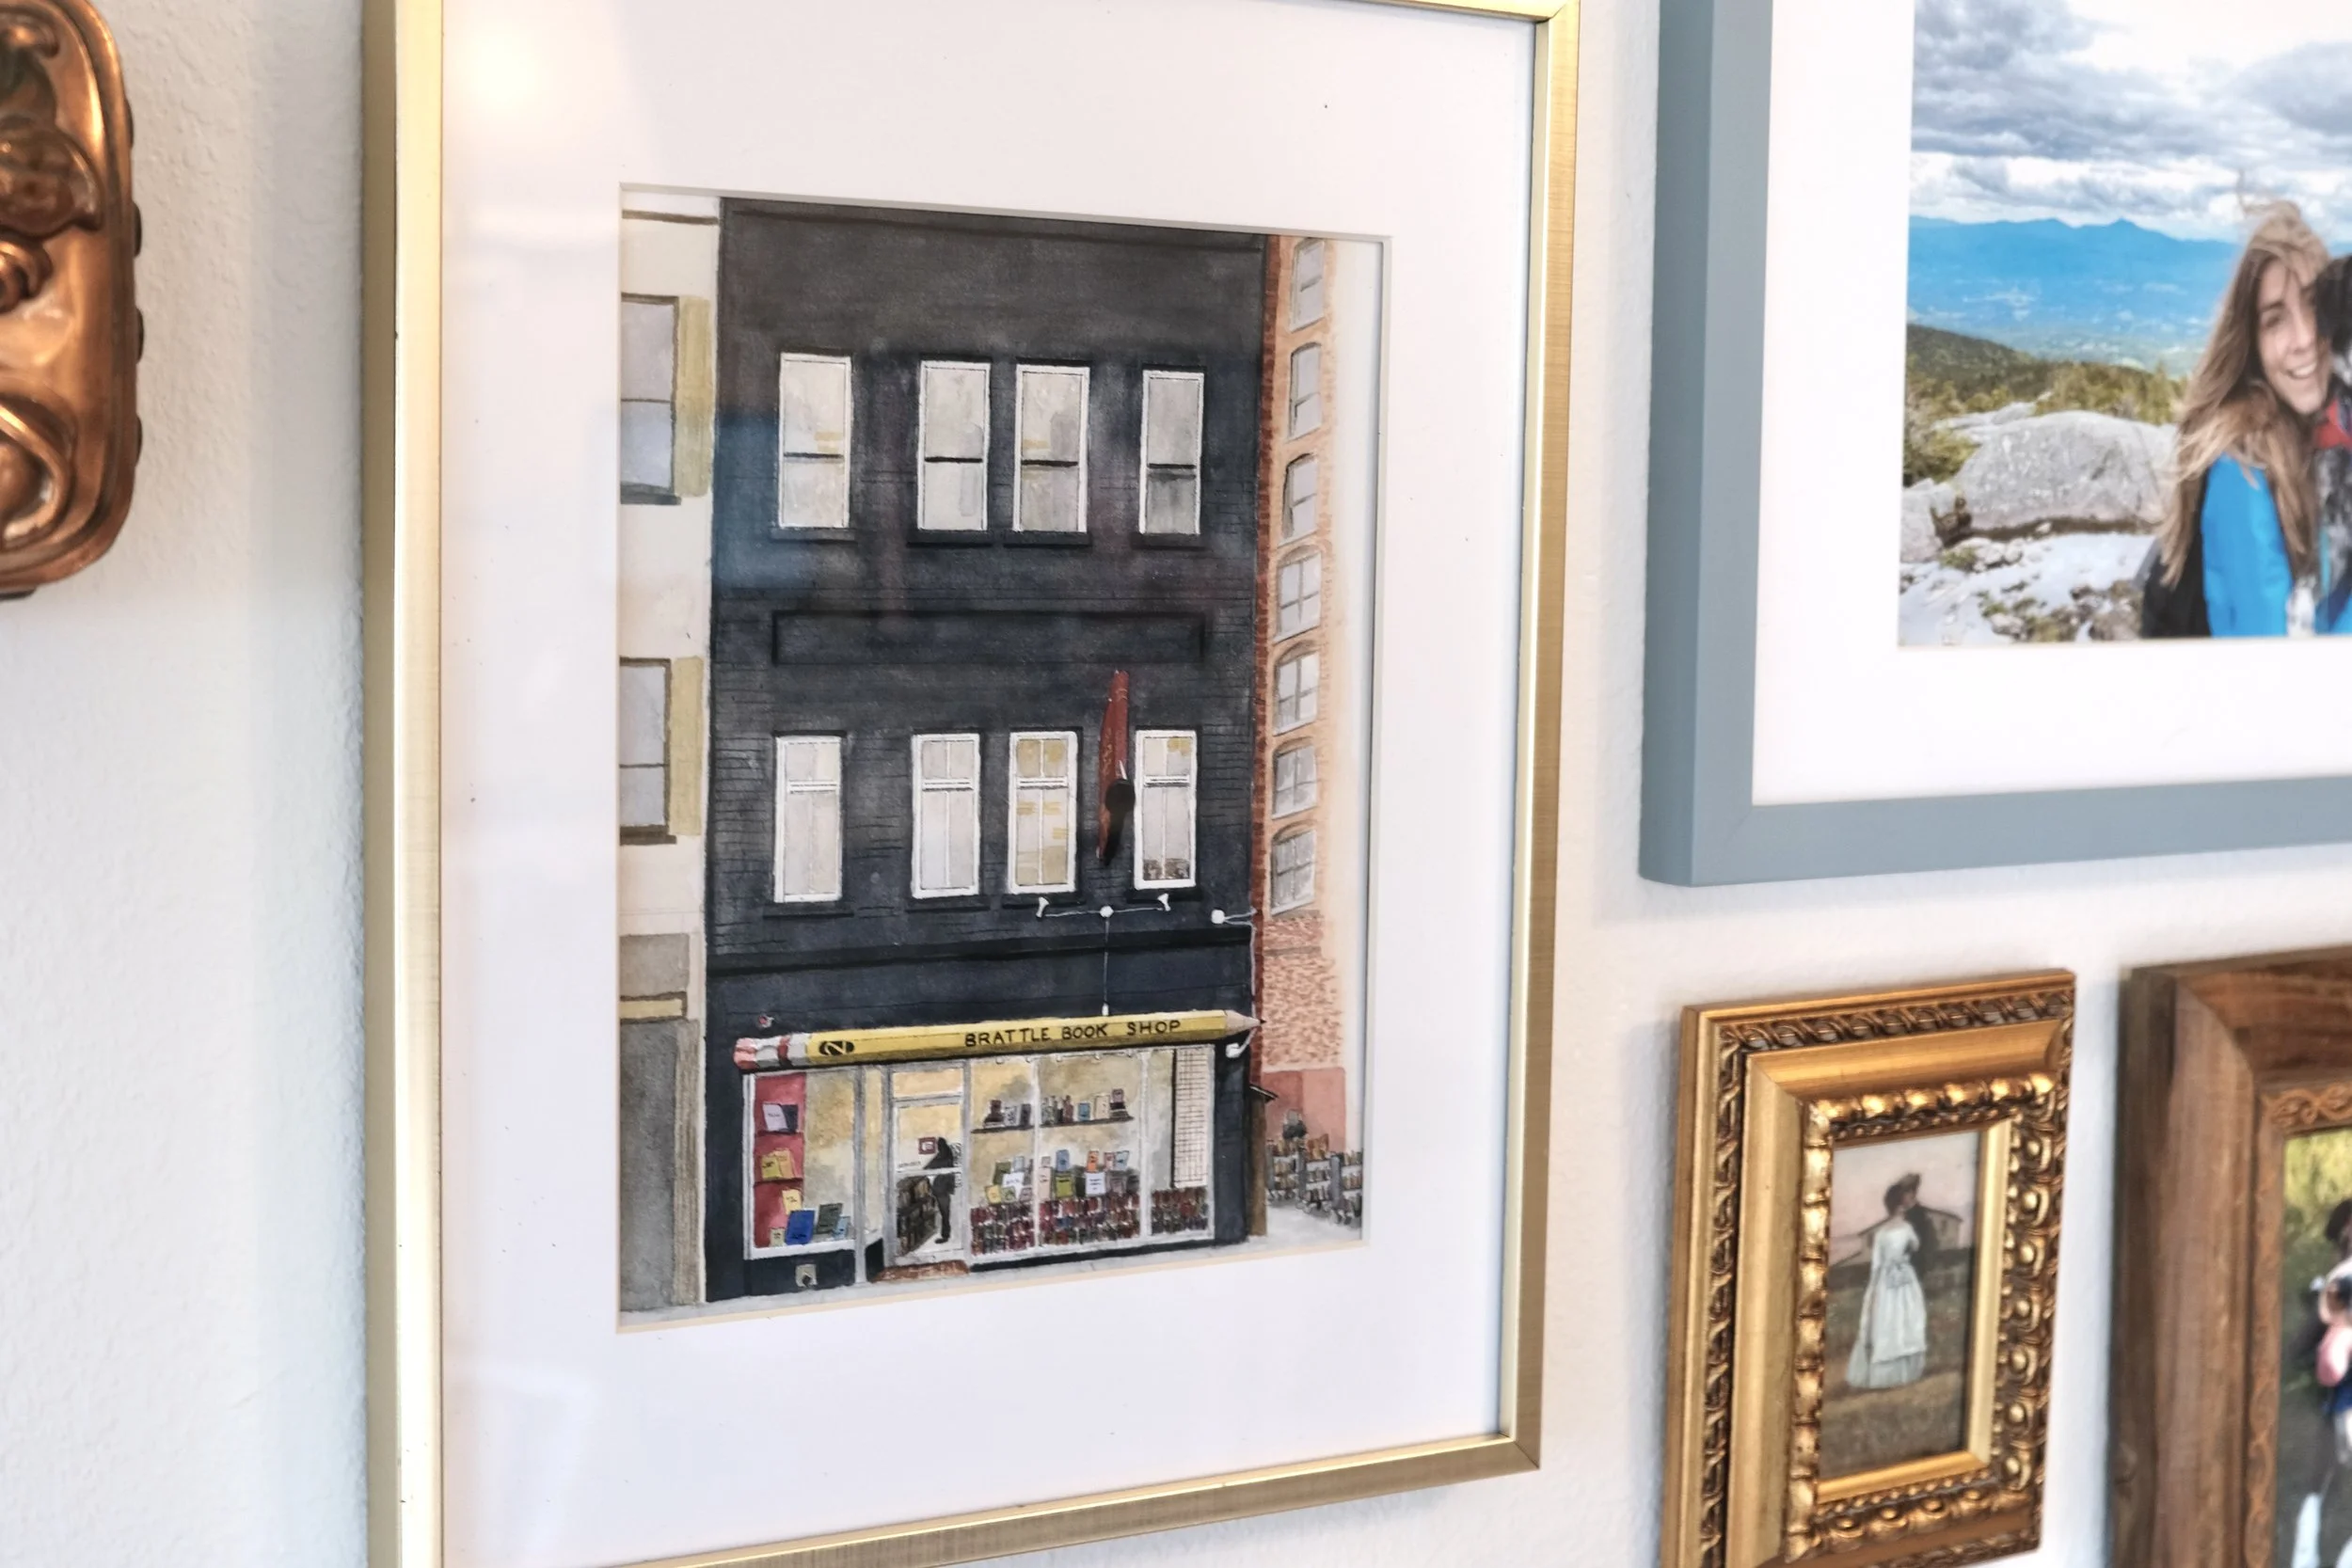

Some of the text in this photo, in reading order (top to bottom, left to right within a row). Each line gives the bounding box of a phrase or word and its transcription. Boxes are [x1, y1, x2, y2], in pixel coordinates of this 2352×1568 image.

[964, 1021, 1181, 1048] BRATTLE BOOK SHOP
